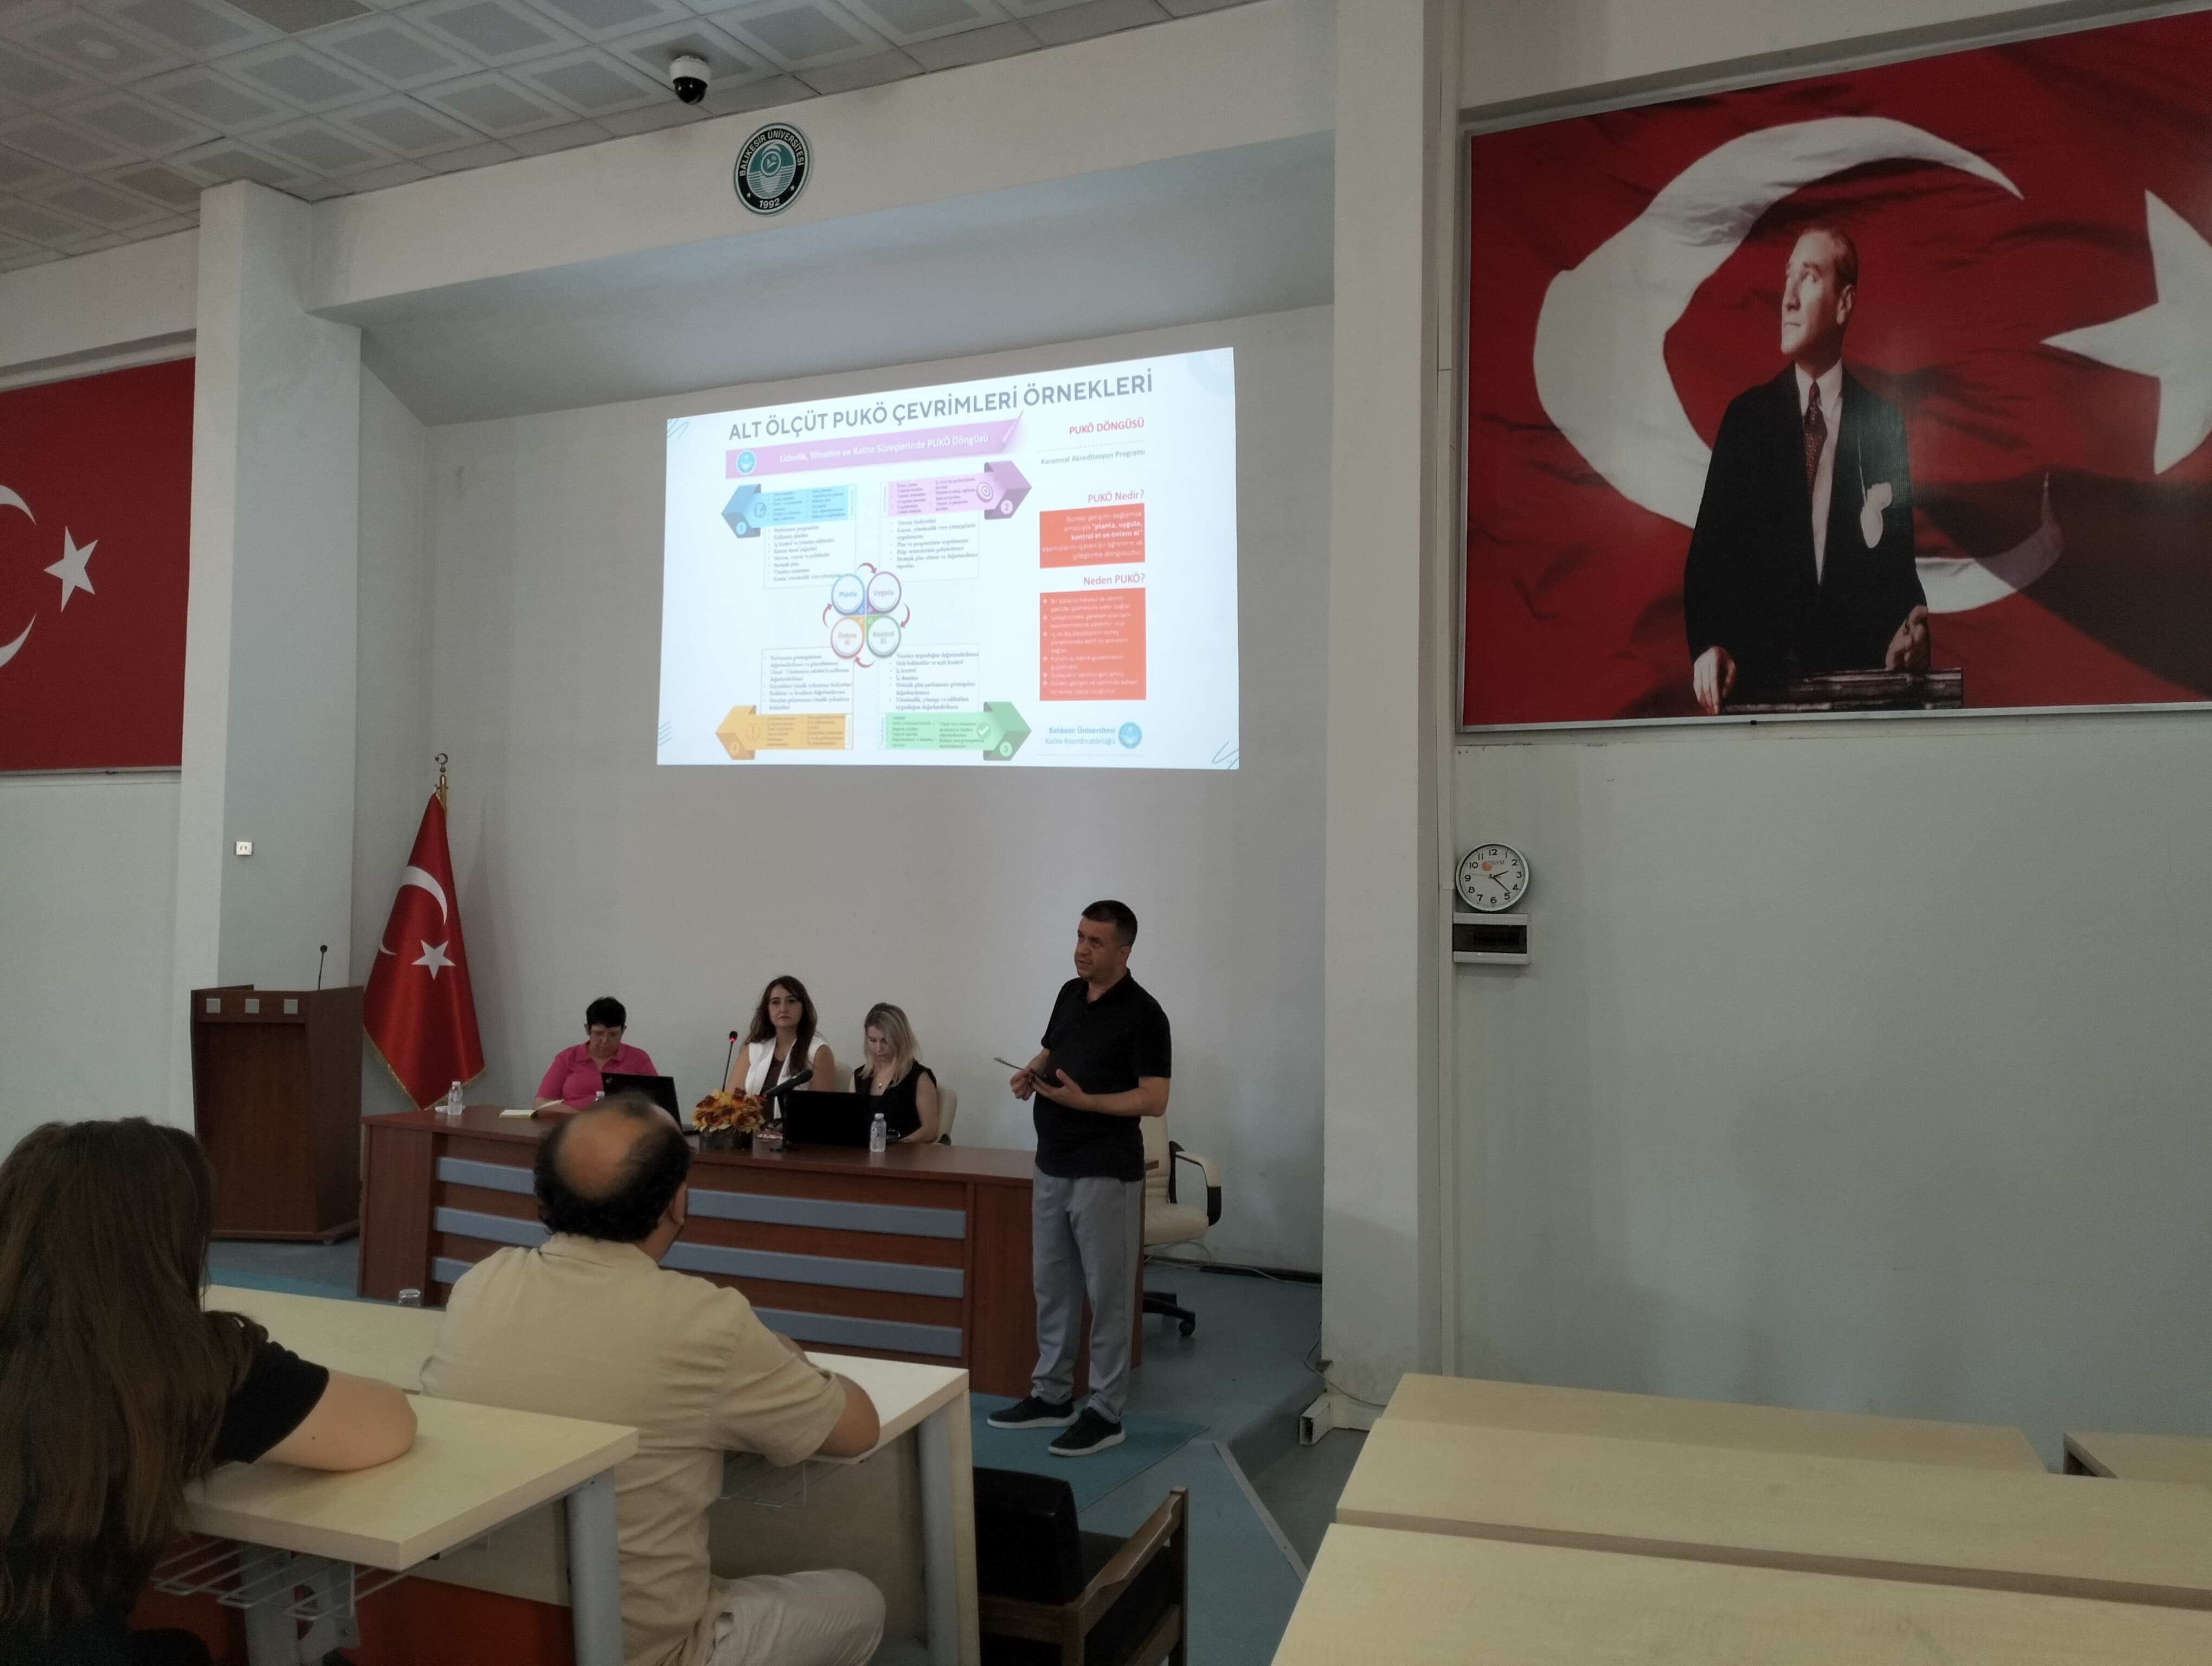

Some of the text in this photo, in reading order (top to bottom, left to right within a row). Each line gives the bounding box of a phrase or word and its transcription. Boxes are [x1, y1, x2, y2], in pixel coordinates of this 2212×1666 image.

[740, 134, 766, 176] BALIKESİR
[760, 198, 780, 209] 1992
[729, 368, 1152, 440] ALT ÖLÇÜT PUKÖ ÇEVRİMLERİ ÖRNEKLERİ
[1069, 416, 1144, 435] PUKÖ DÖNGÜSÜ
[810, 450, 841, 460] Yönetim
[853, 445, 874, 454] Kalite
[877, 440, 925, 455] Süreçlerinde
[928, 435, 950, 448] PUKÖ
[952, 434, 988, 446] Döngüsü
[1040, 449, 1145, 465] Kurumsal Akreditasyon Programı
[1088, 489, 1144, 503] PUKÖ Nedir?
[1084, 573, 1146, 586] Neden PUKÖ?
[1077, 725, 1115, 734] Üniversitesi
